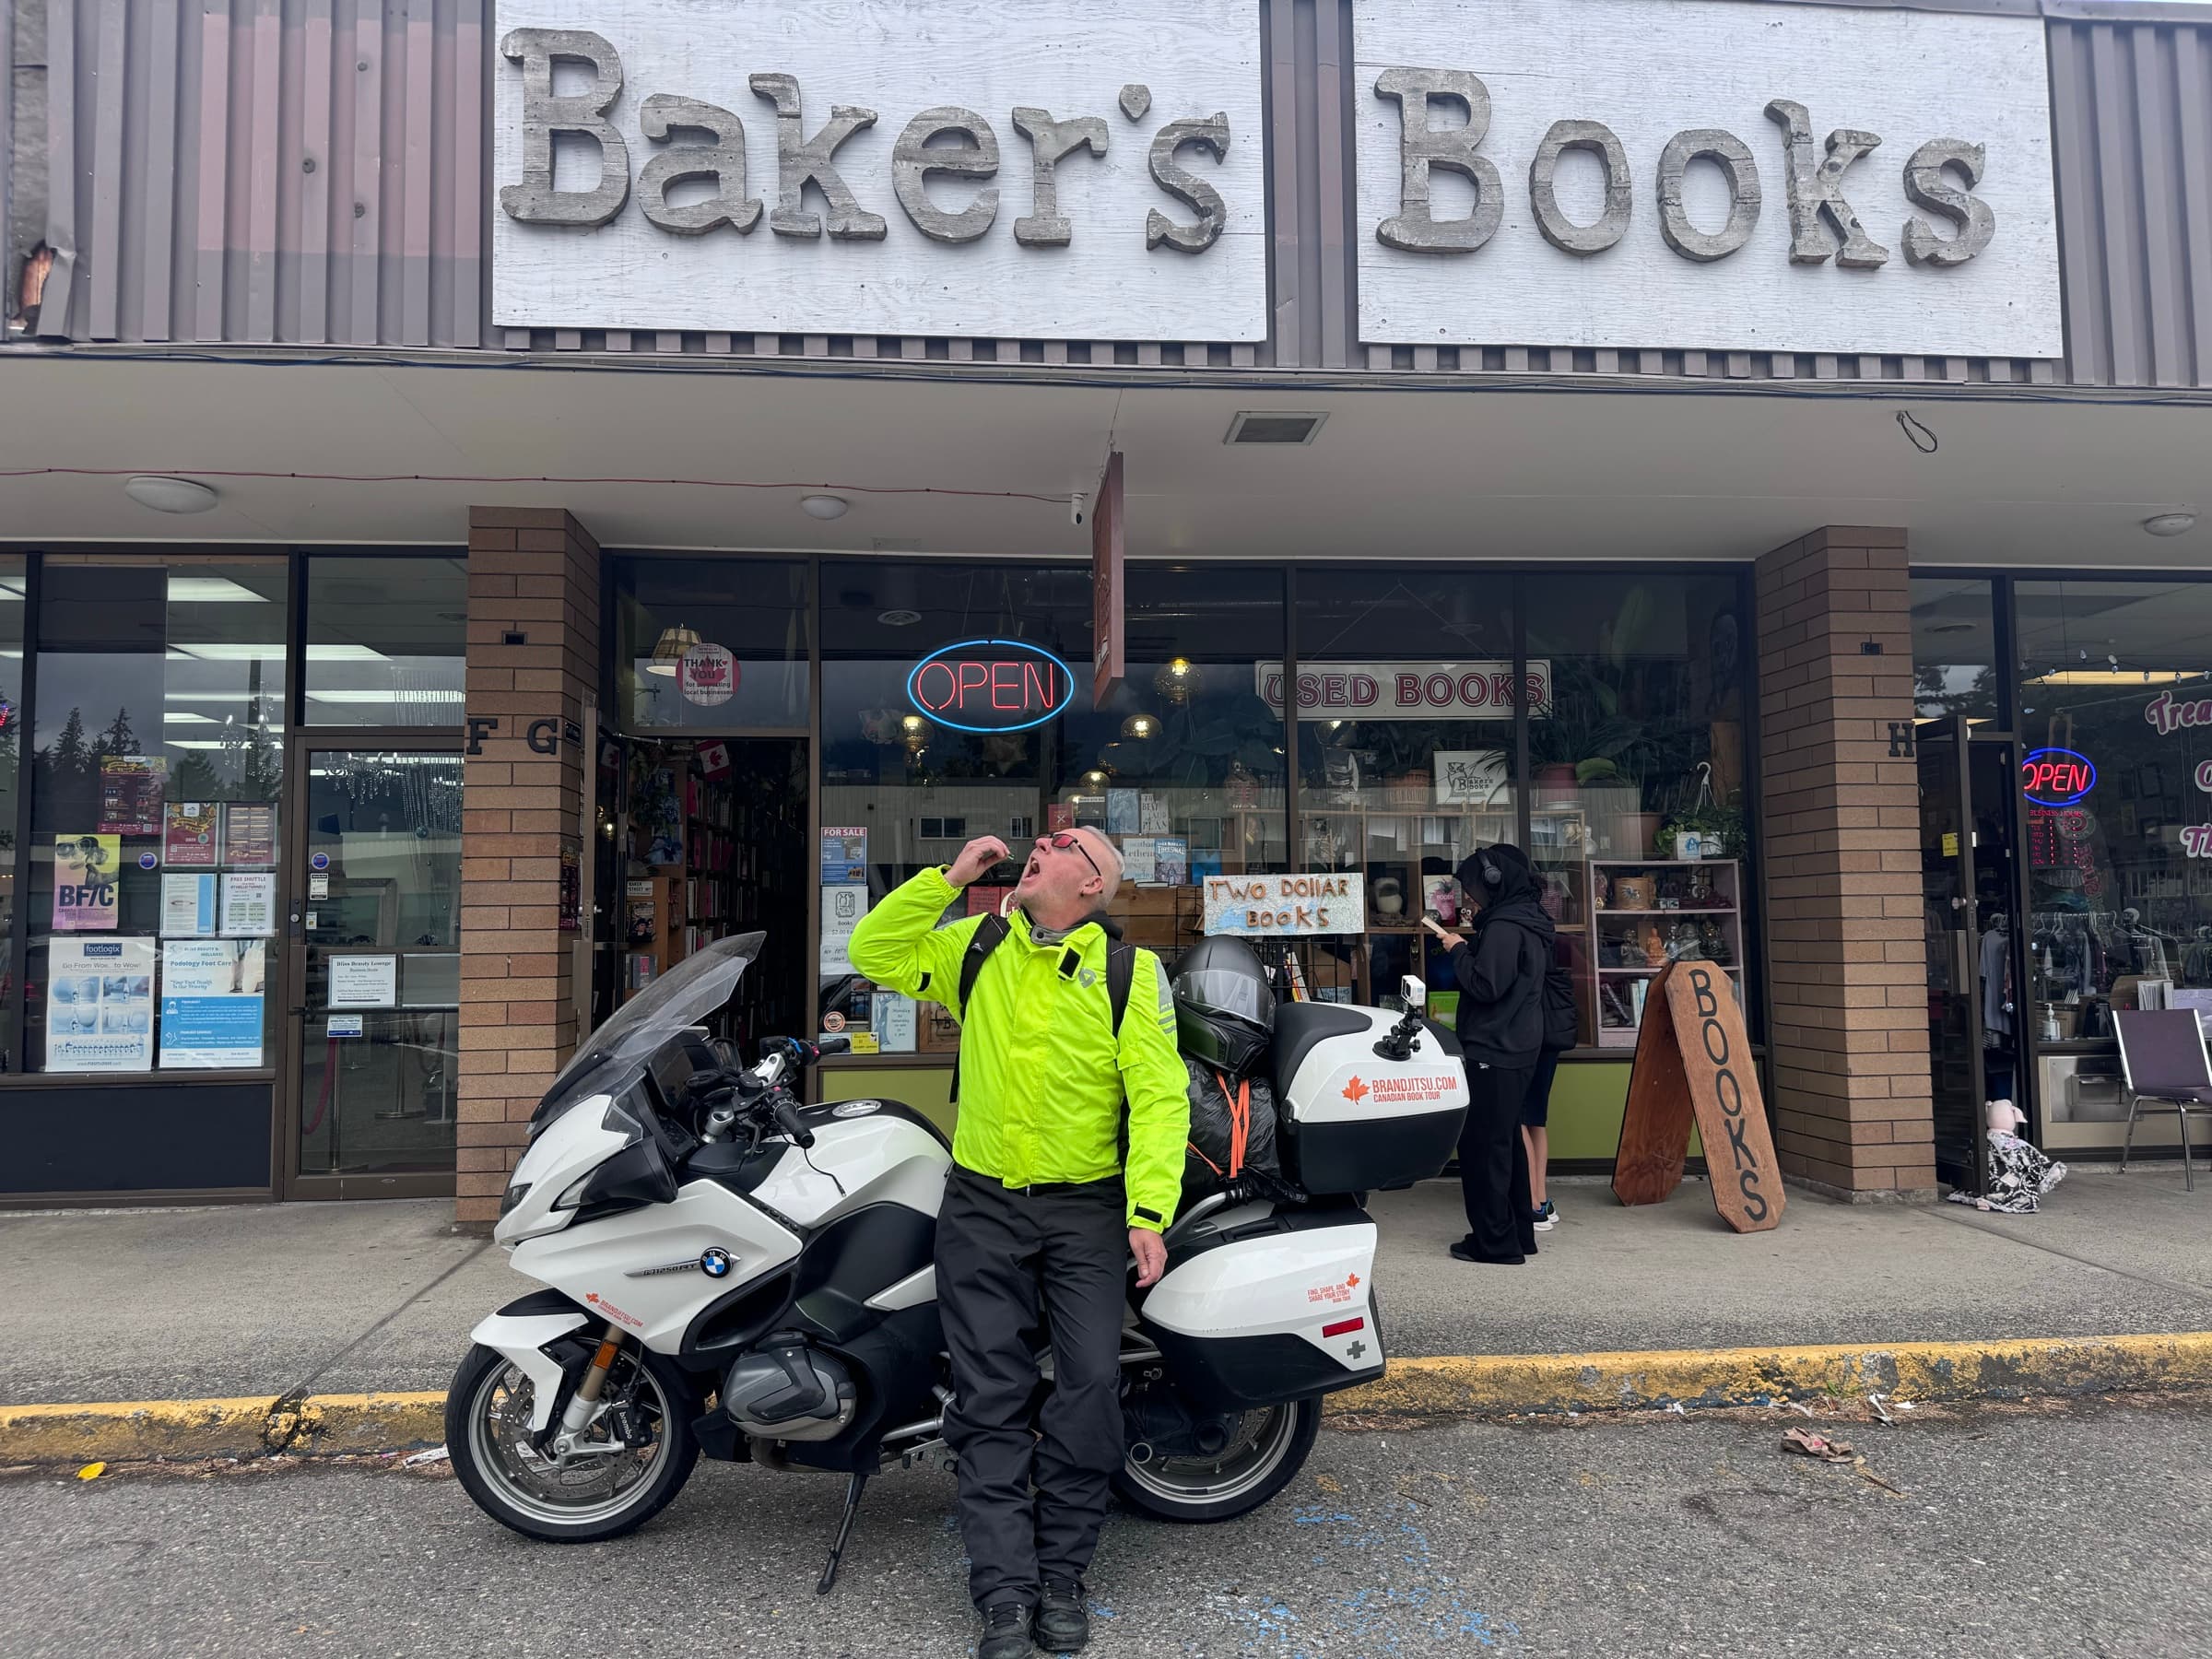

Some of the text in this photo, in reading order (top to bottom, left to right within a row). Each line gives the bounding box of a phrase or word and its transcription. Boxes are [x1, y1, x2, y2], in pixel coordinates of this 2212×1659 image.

[500, 27, 1995, 271] Baker's Books
[684, 659, 723, 667] THANK
[917, 662, 1054, 710] OPEN
[1264, 673, 1546, 707] USED BOOKS
[466, 718, 558, 755] F G
[1888, 723, 1914, 757] H
[2022, 763, 2088, 792] OPEN
[59, 884, 114, 907] BF/C
[1208, 880, 1267, 900] TWO
[1246, 906, 1330, 928] BOOKS
[86, 945, 120, 954] footlogix
[1371, 1076, 1457, 1094] BRANDJITSU.COM
[1373, 1090, 1441, 1103] CANADIAN BOOK TOUR
[1688, 968, 1768, 1222] BOOKS
[702, 1251, 726, 1262] BMW
[619, 1411, 632, 1440] brembo
